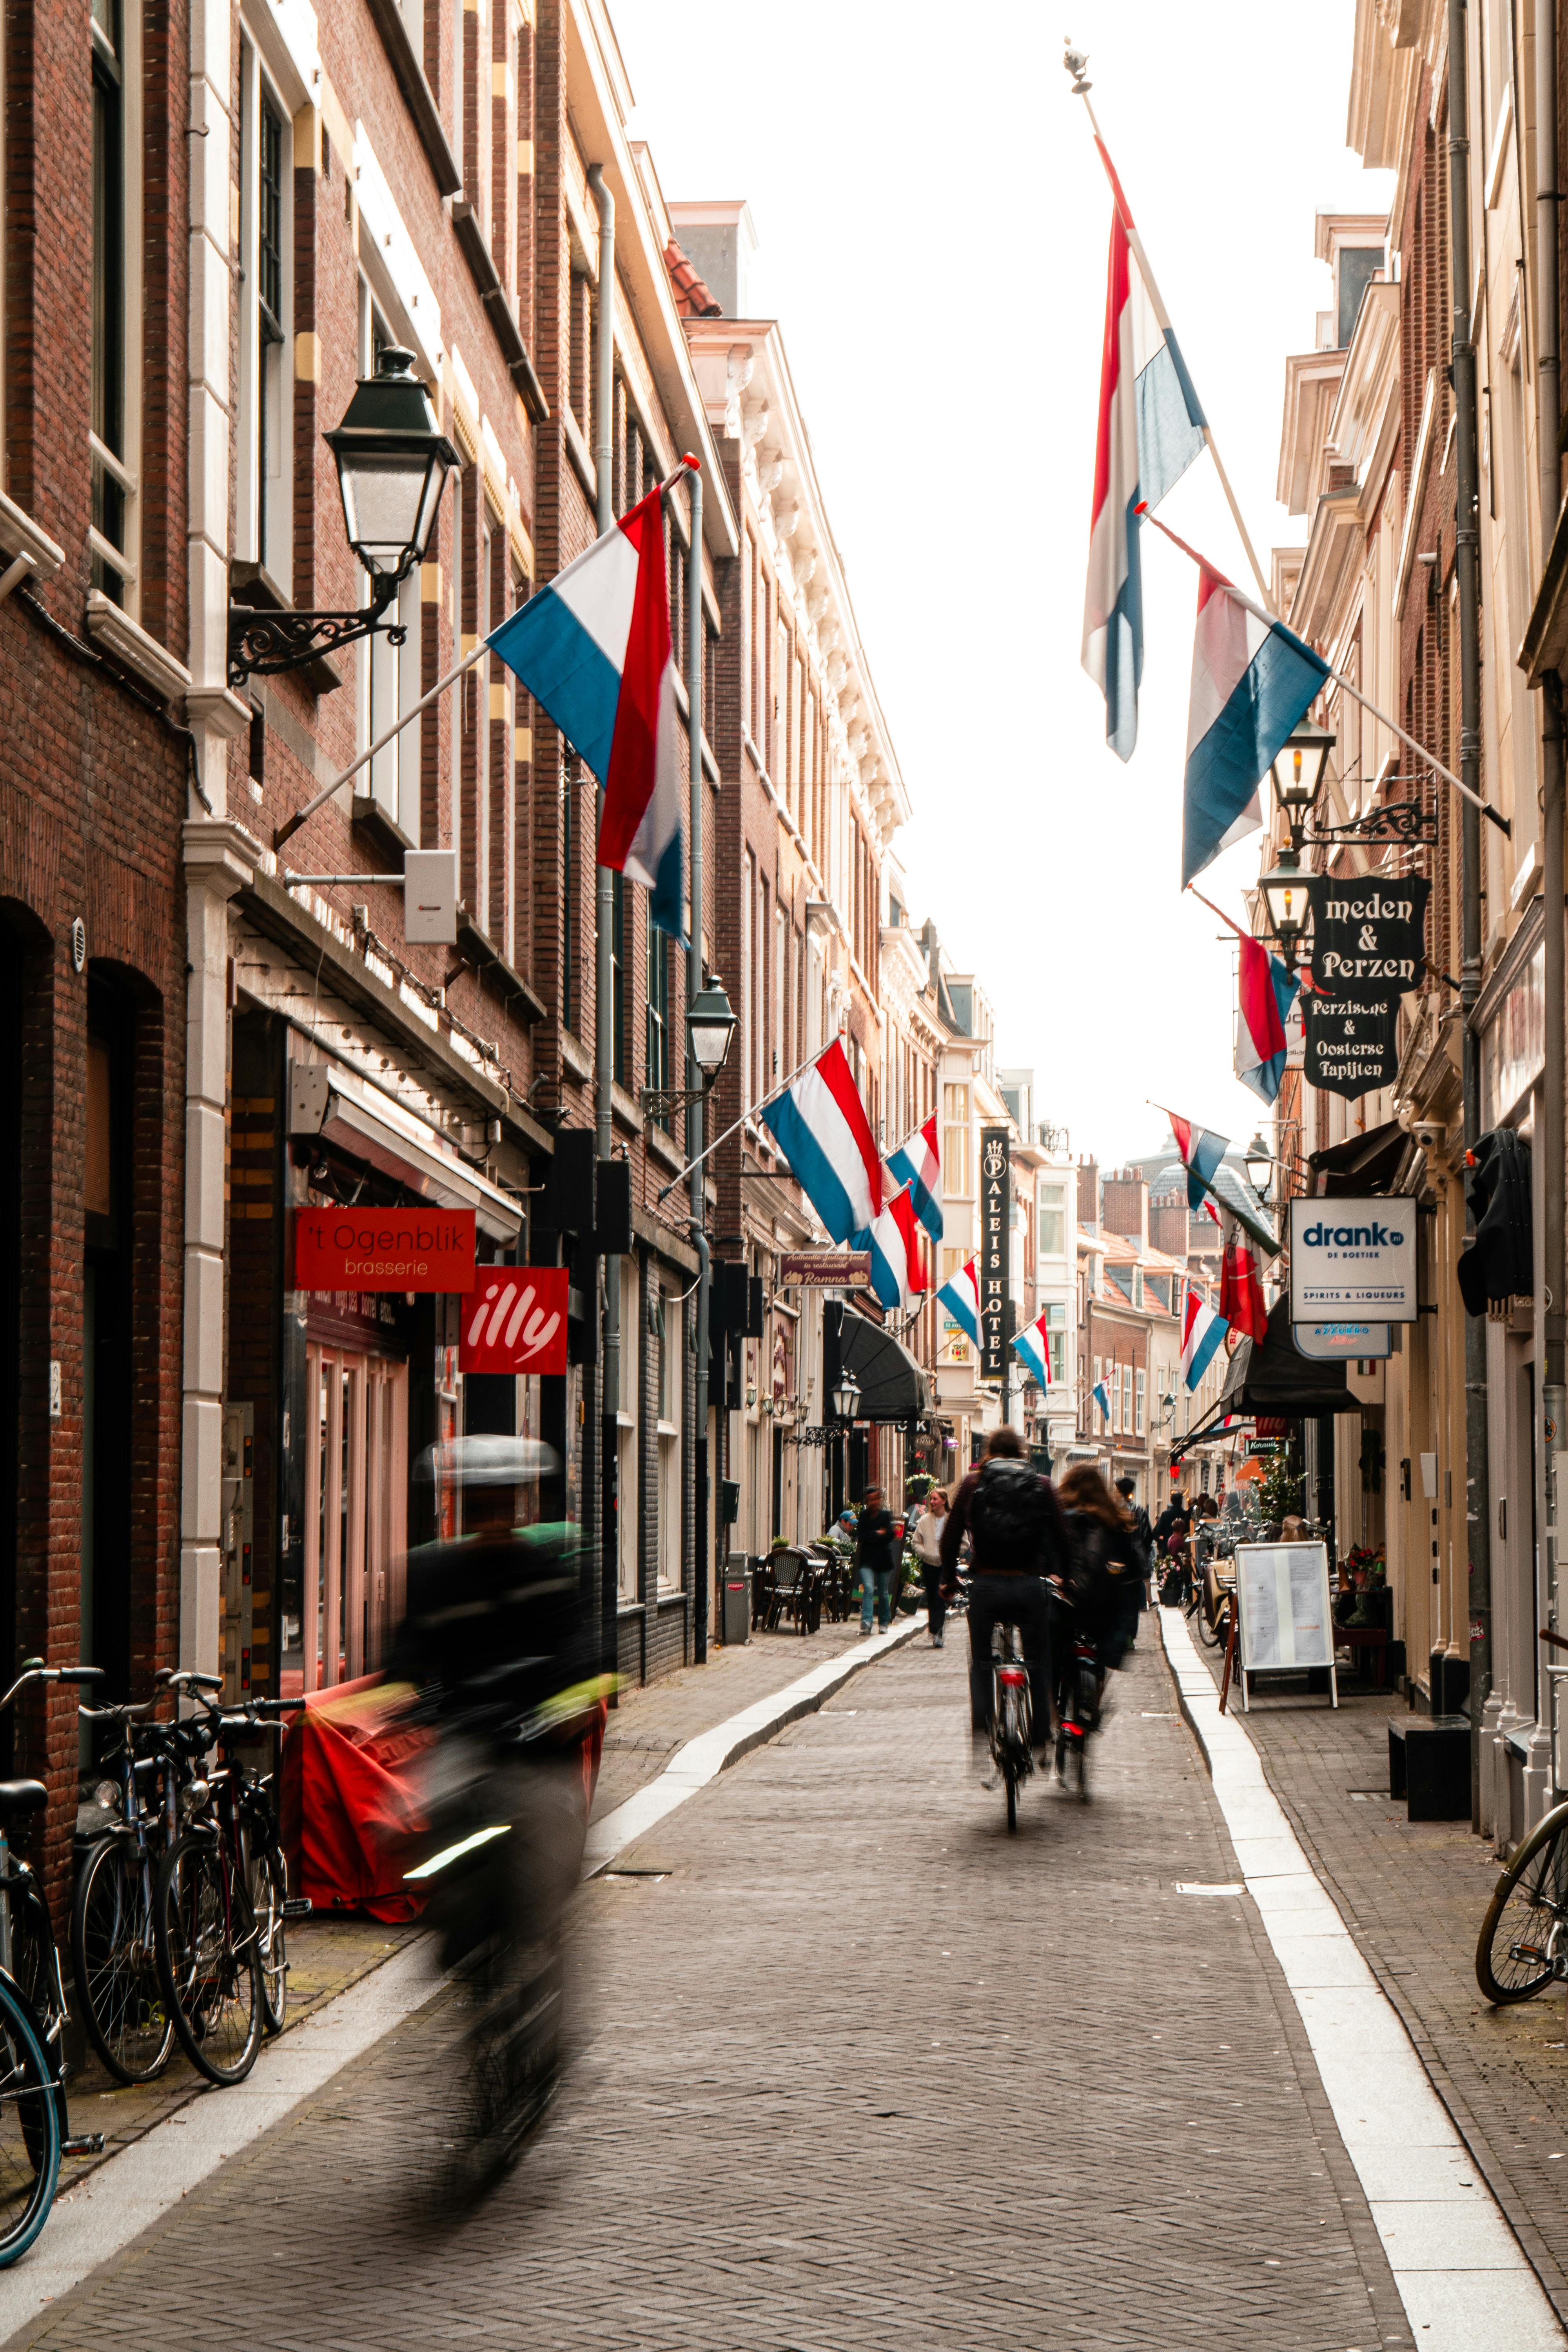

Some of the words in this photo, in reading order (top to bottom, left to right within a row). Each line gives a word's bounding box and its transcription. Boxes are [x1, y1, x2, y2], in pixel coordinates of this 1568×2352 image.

[1357, 924, 1378, 951] &
[1323, 951, 1415, 982] Perzen
[1343, 1020, 1355, 1035] &
[1316, 1040, 1384, 1056] Oosterse
[1319, 1060, 1383, 1081] Tapijten
[987, 1158, 1003, 1269] PALEIS
[334, 1225, 465, 1256] Ogenblik
[344, 1258, 428, 1276] brasserie
[804, 1272, 848, 1285] Ramna
[468, 1282, 561, 1363] illy
[988, 1280, 1002, 1368] HOTEL
